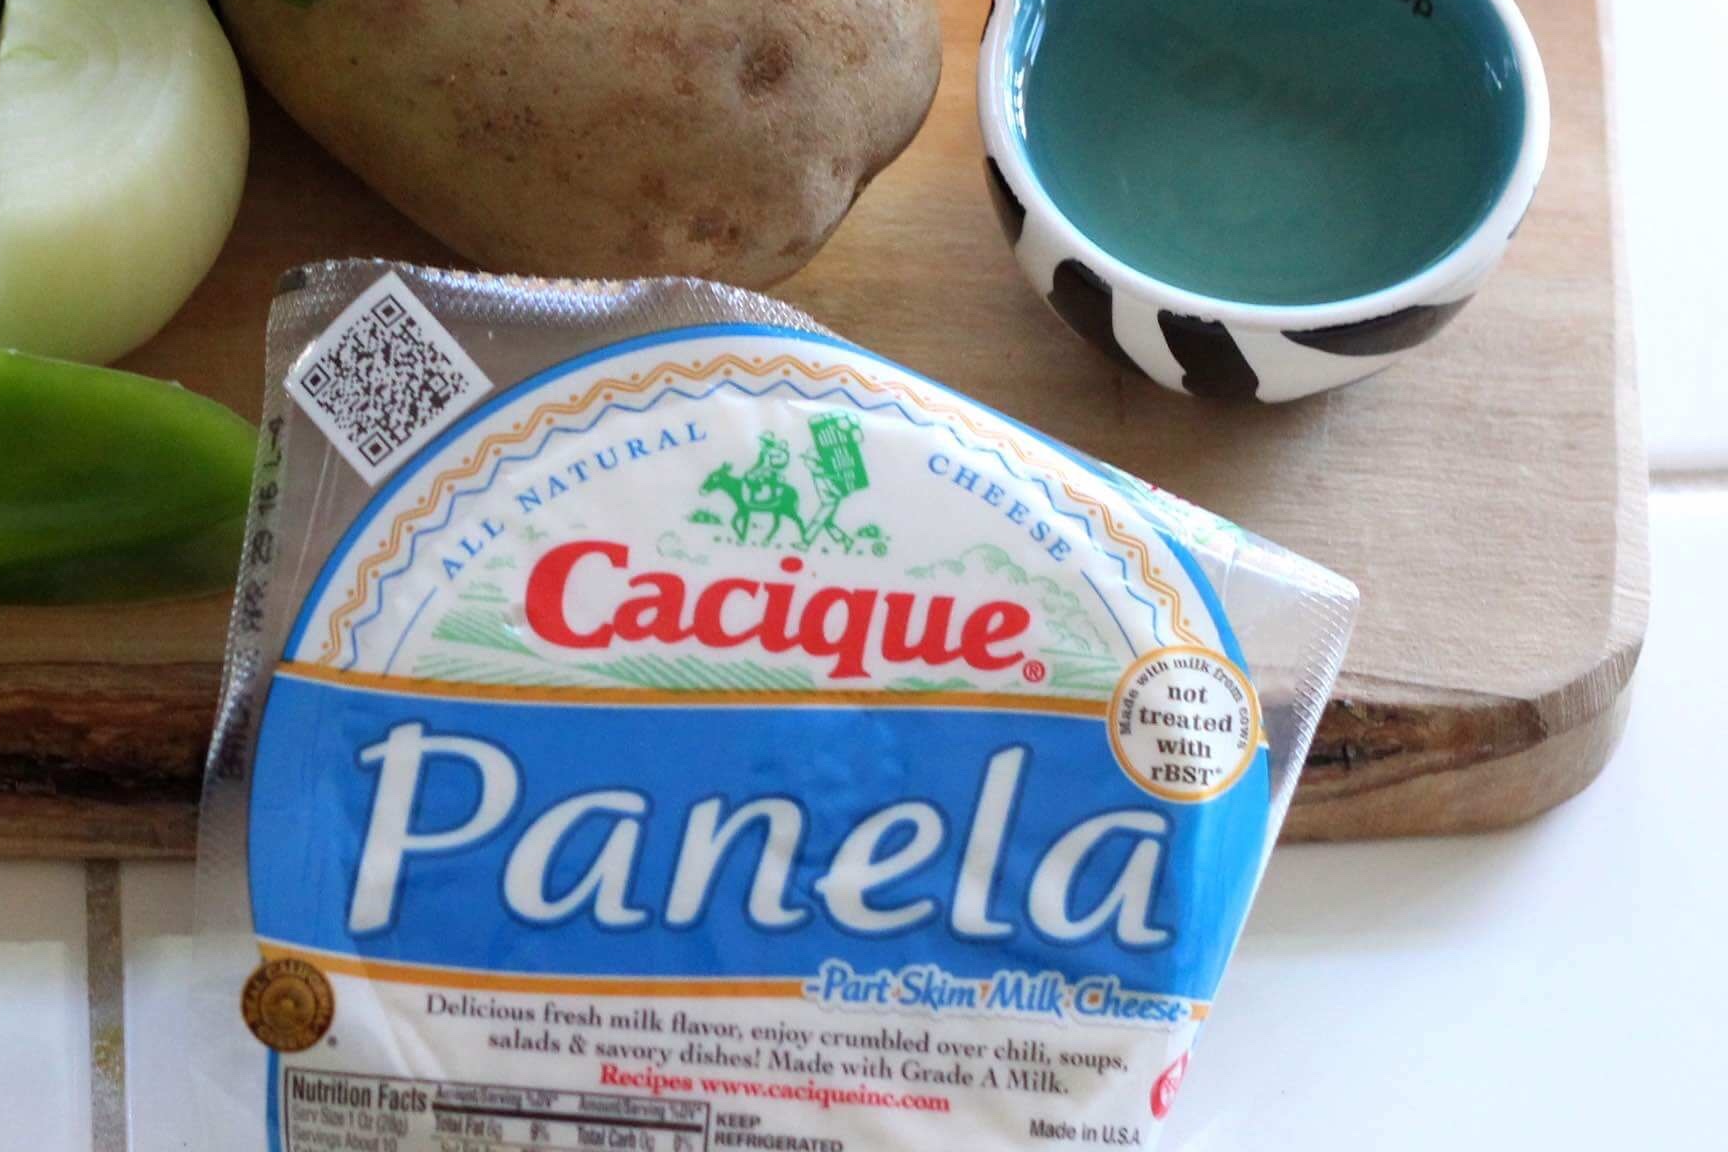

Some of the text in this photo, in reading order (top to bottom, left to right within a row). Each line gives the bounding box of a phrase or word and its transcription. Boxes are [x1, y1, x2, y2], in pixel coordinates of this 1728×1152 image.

[440, 421, 1073, 582] ALL NATURAL CHEESE
[1119, 688, 1140, 736] Made
[1136, 660, 1170, 688] with
[1172, 656, 1212, 674] milk
[1212, 667, 1244, 704] from
[1166, 684, 1210, 704] not
[1138, 705, 1234, 734] treated
[1155, 736, 1213, 759] with
[342, 718, 1178, 950] Panela
[899, 969, 977, 1012] Skim
[986, 971, 1064, 1018] Milk
[425, 992, 1129, 1076] Delicious fresh milk flavor, enjoy crumbled over chili, soups,
[487, 1027, 1070, 1097] salads & savory dishes! Made with Grade A Milk.
[291, 1074, 372, 1109] Nutrition
[376, 1085, 429, 1113] Facts
[598, 1061, 952, 1113] Recipes www.caciqueinc.com
[714, 1131, 844, 1152] REFRIGERATED
[715, 1113, 762, 1130] KEEP
[1029, 1118, 1077, 1140] Made
[1081, 1122, 1099, 1142] in
